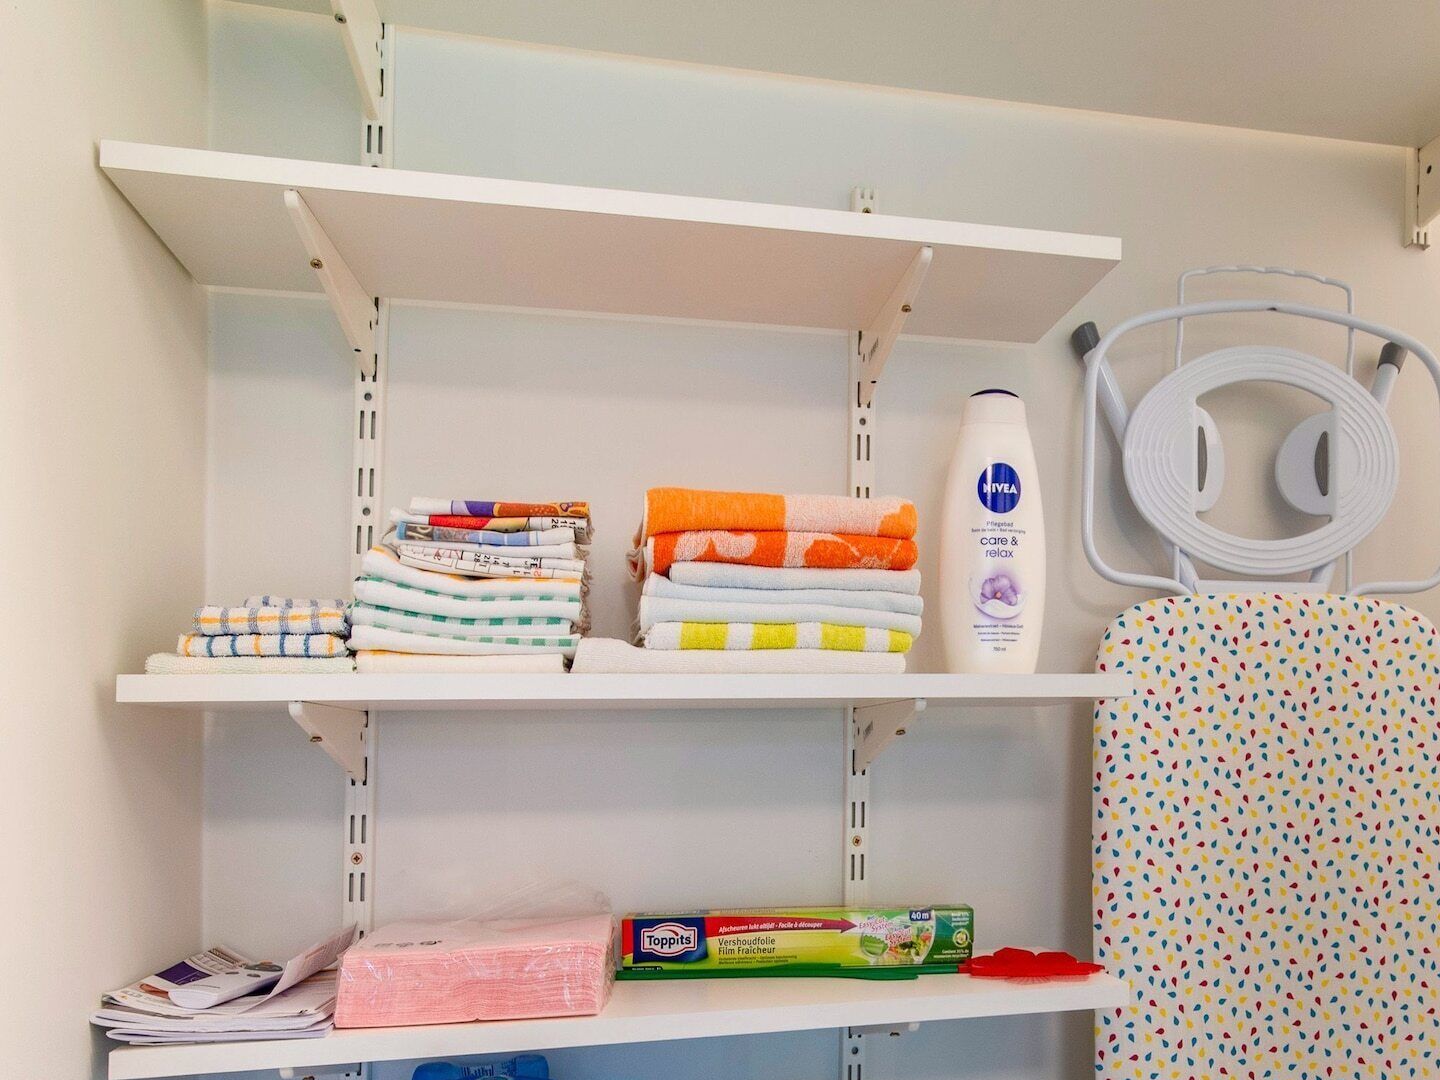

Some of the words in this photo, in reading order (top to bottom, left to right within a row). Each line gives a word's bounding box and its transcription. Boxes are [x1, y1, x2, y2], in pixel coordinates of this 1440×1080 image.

[983, 482, 1018, 494] NIVEA
[980, 536, 1008, 546] care
[1010, 535, 1018, 546] &
[985, 546, 1014, 558] relax
[646, 935, 692, 949] Toppits
[718, 936, 776, 947] Vershoudfolie
[718, 946, 735, 956] Film
[737, 945, 776, 955] Fraîcheur
